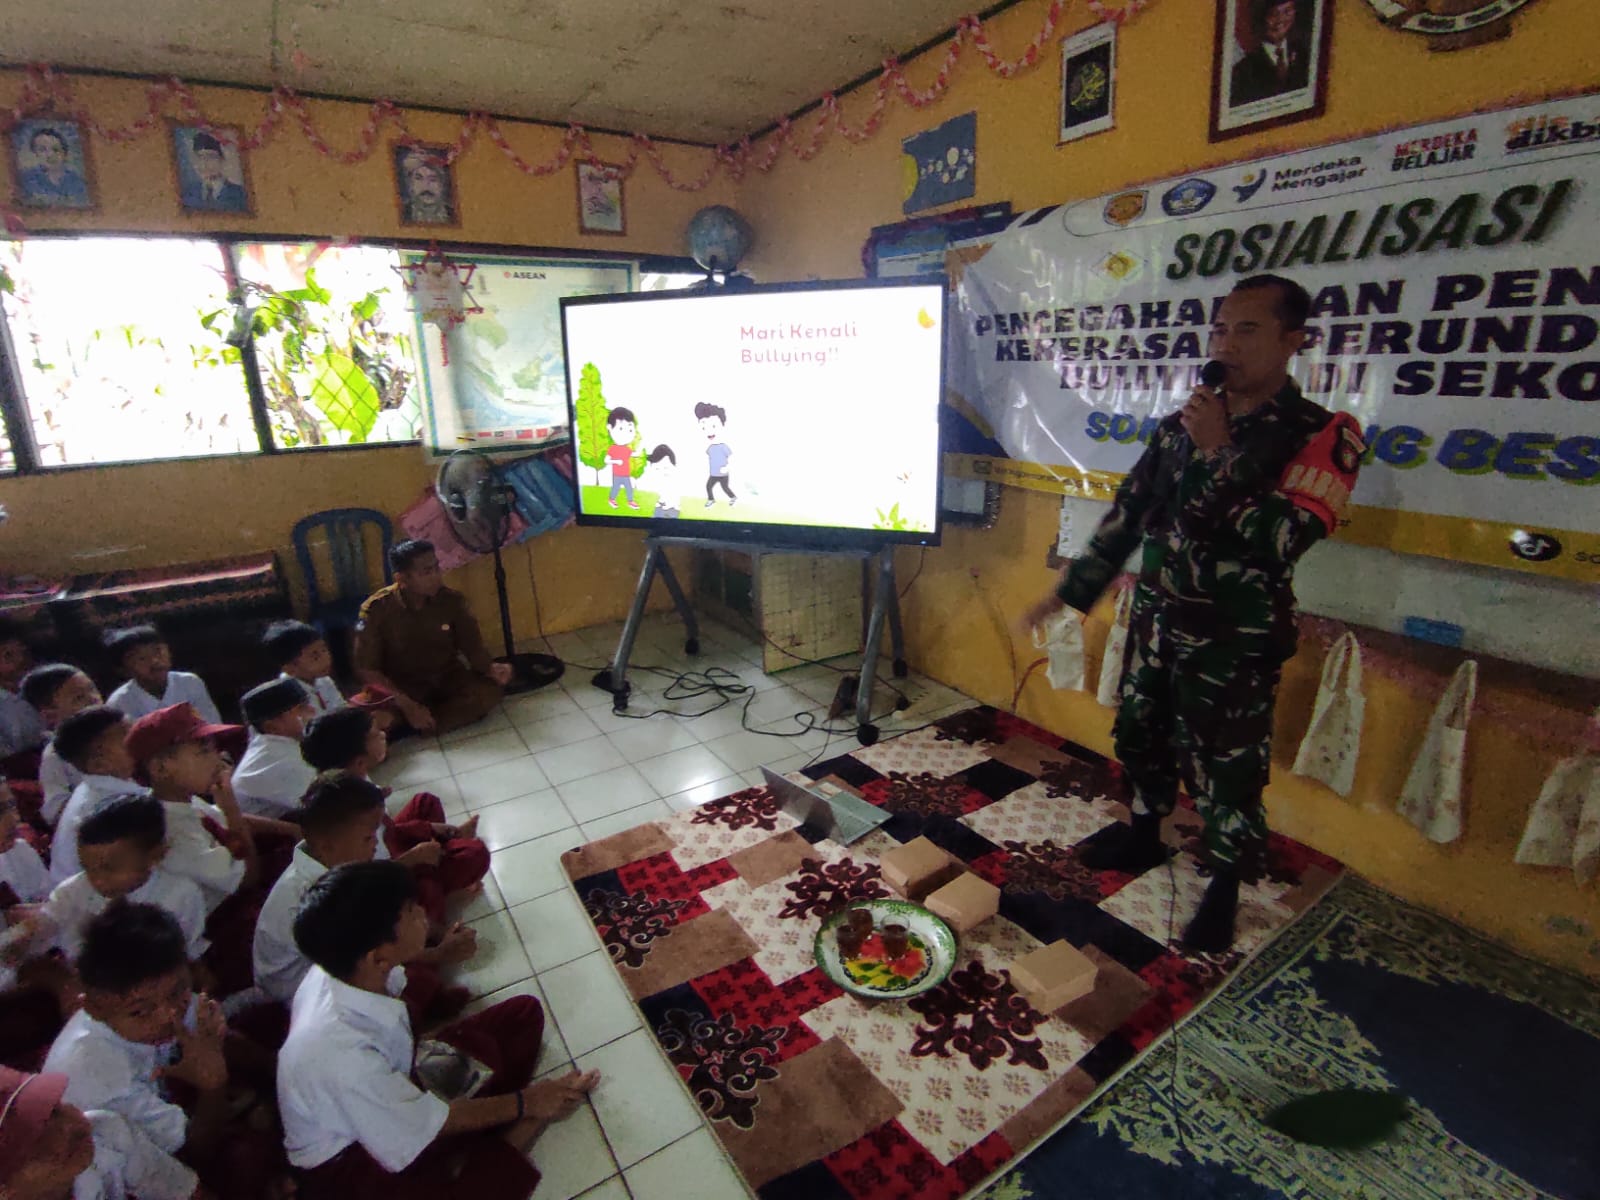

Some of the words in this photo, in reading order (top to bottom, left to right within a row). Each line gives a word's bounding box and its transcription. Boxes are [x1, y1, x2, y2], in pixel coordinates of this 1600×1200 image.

[1395, 128, 1479, 157] MERDEKA
[1505, 121, 1600, 149] dikb
[1275, 155, 1362, 180] Merdeka
[1392, 144, 1476, 172] BELAJAR
[1271, 167, 1368, 193] Mengajar
[1166, 178, 1574, 281] SOSIALISASI
[512, 271, 547, 280] ASEAN
[1308, 279, 1405, 318] AN
[740, 323, 785, 340] Mari
[790, 321, 858, 339] Kenali
[996, 332, 1212, 361] KEKERASA
